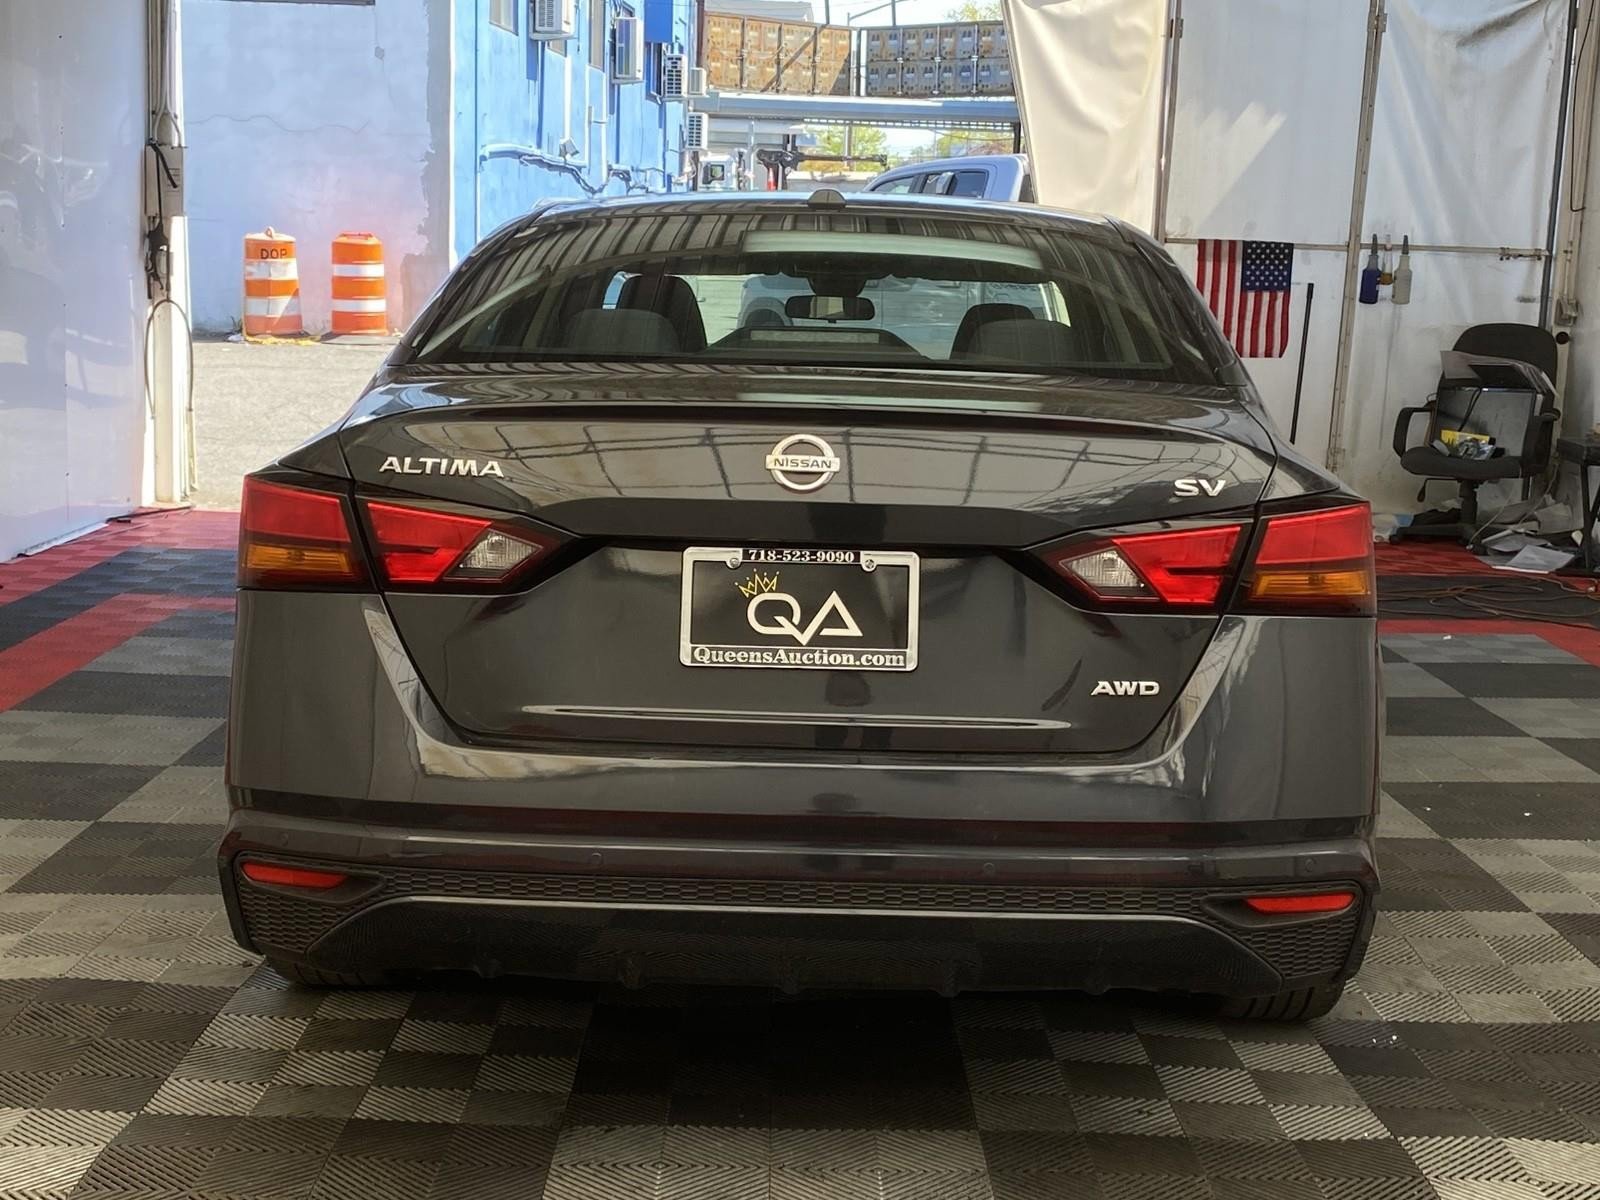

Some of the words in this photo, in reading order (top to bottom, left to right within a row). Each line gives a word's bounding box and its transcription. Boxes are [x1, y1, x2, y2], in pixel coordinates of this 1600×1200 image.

[379, 456, 504, 478] ALTIMA
[774, 457, 832, 469] NISSAN
[1173, 478, 1226, 497] SV
[748, 549, 855, 564] 718-523-9090
[693, 647, 905, 668] QueensAuction.com
[1092, 681, 1160, 697] AWD
